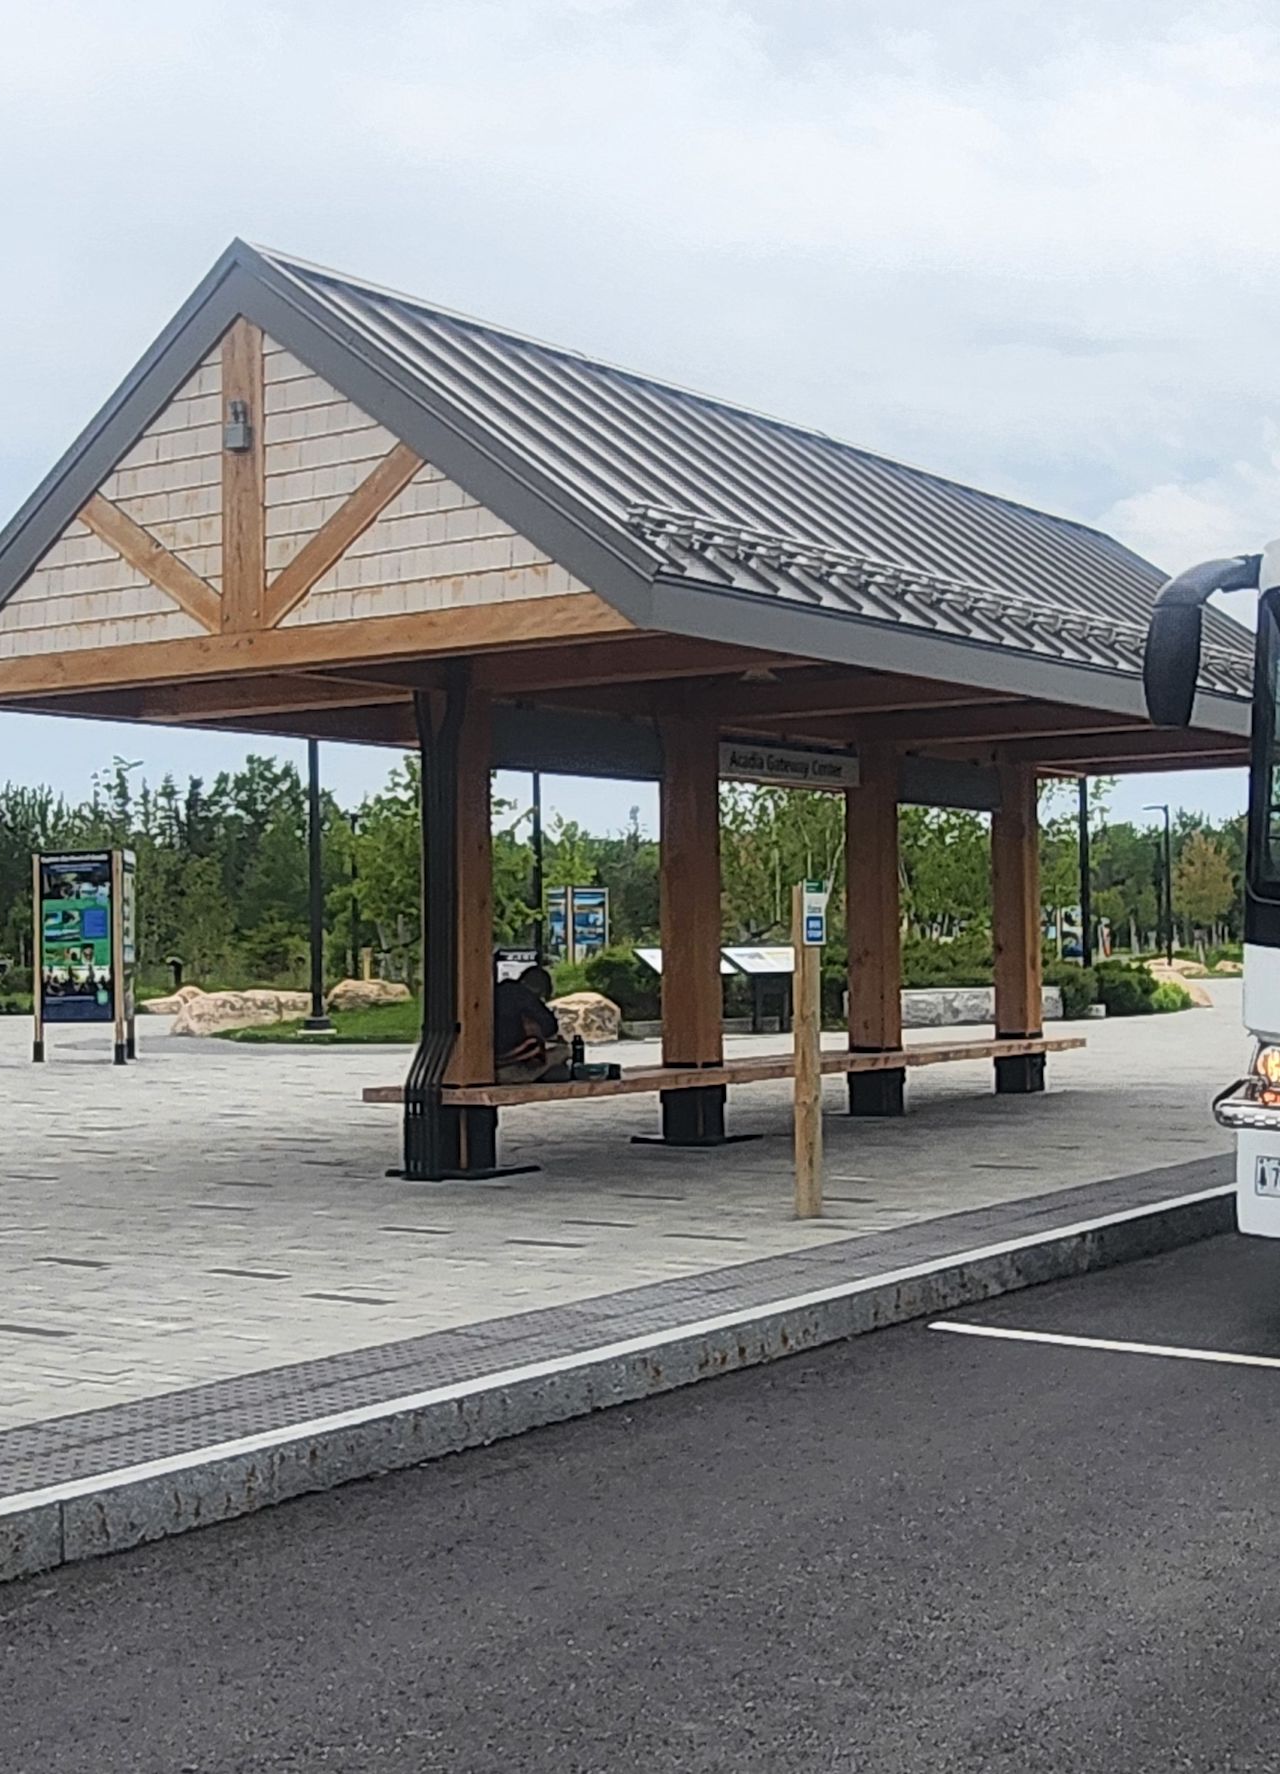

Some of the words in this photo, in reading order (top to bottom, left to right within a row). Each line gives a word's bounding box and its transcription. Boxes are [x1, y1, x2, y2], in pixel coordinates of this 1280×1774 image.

[729, 750, 765, 771] Acadia
[766, 753, 810, 779] Gateway
[811, 758, 843, 778] Center
